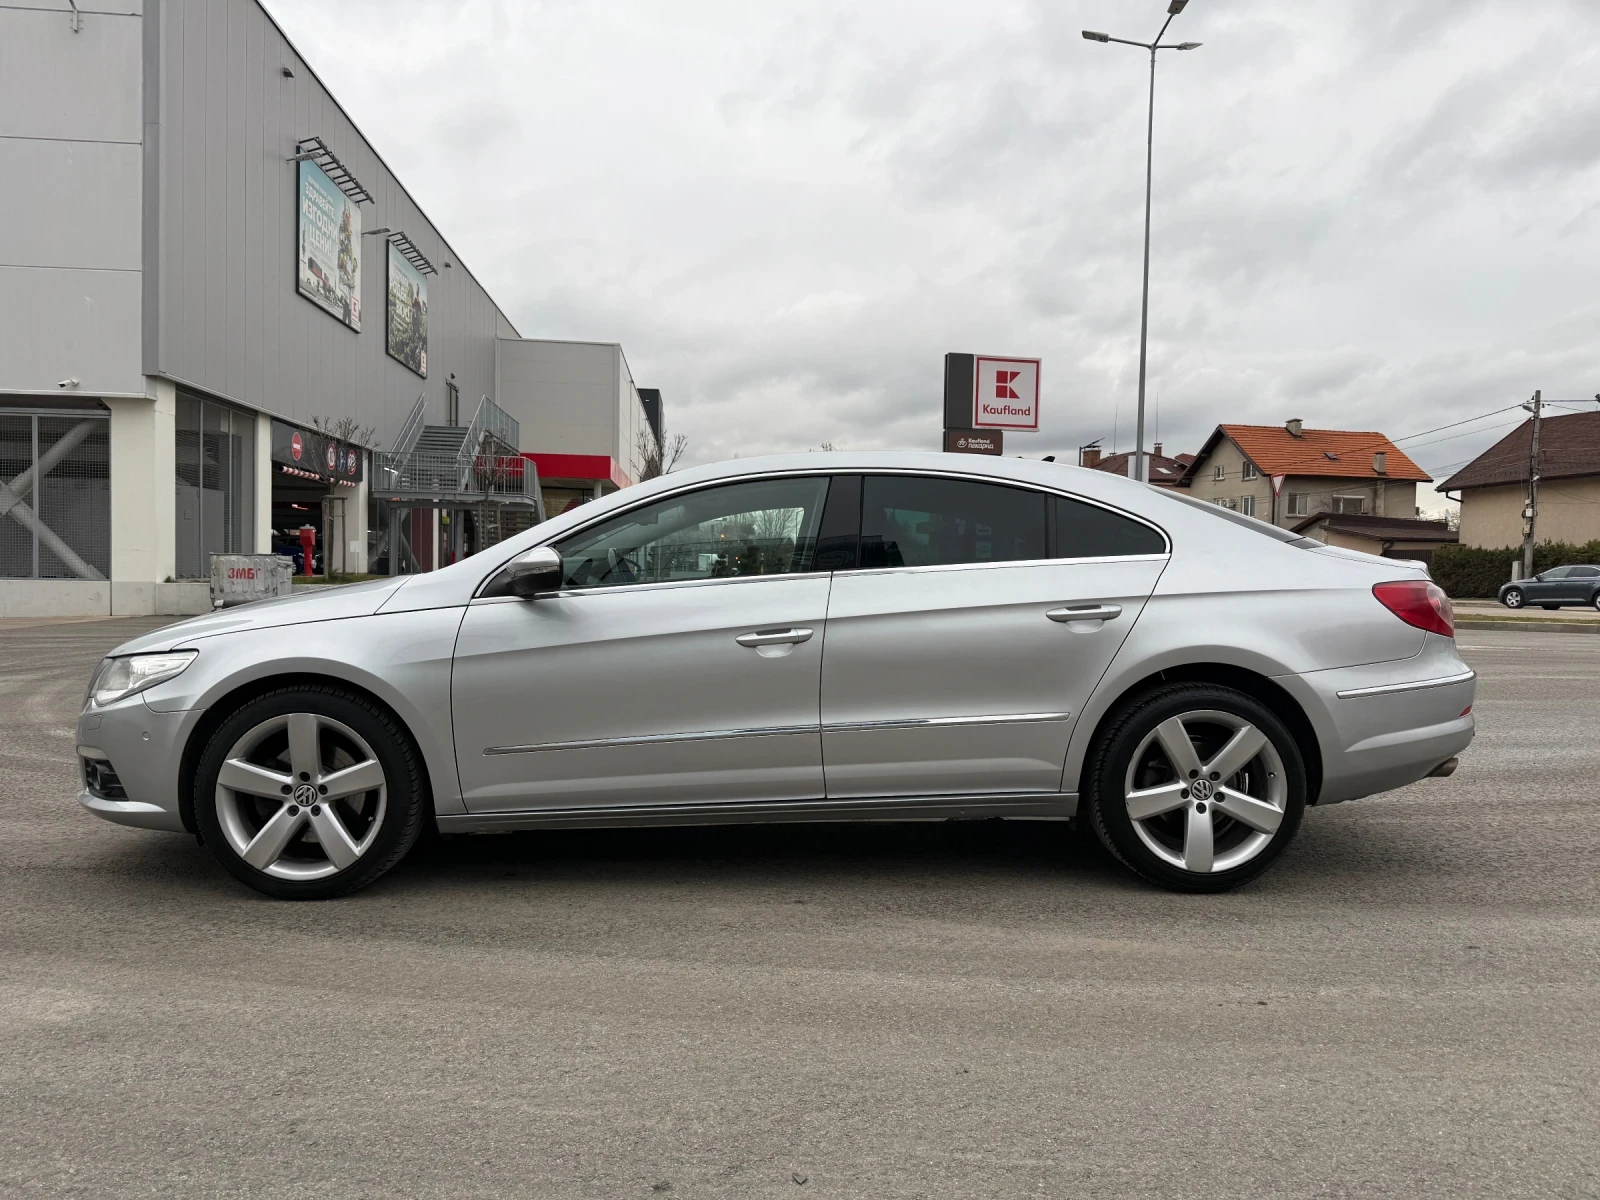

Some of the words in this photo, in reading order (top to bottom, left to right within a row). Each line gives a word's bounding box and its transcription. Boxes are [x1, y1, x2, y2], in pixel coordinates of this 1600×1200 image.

[302, 196, 338, 242] ИЗГОДНИ
[309, 224, 332, 257] ЦЕНИ!
[983, 404, 1031, 416] Kaufland
